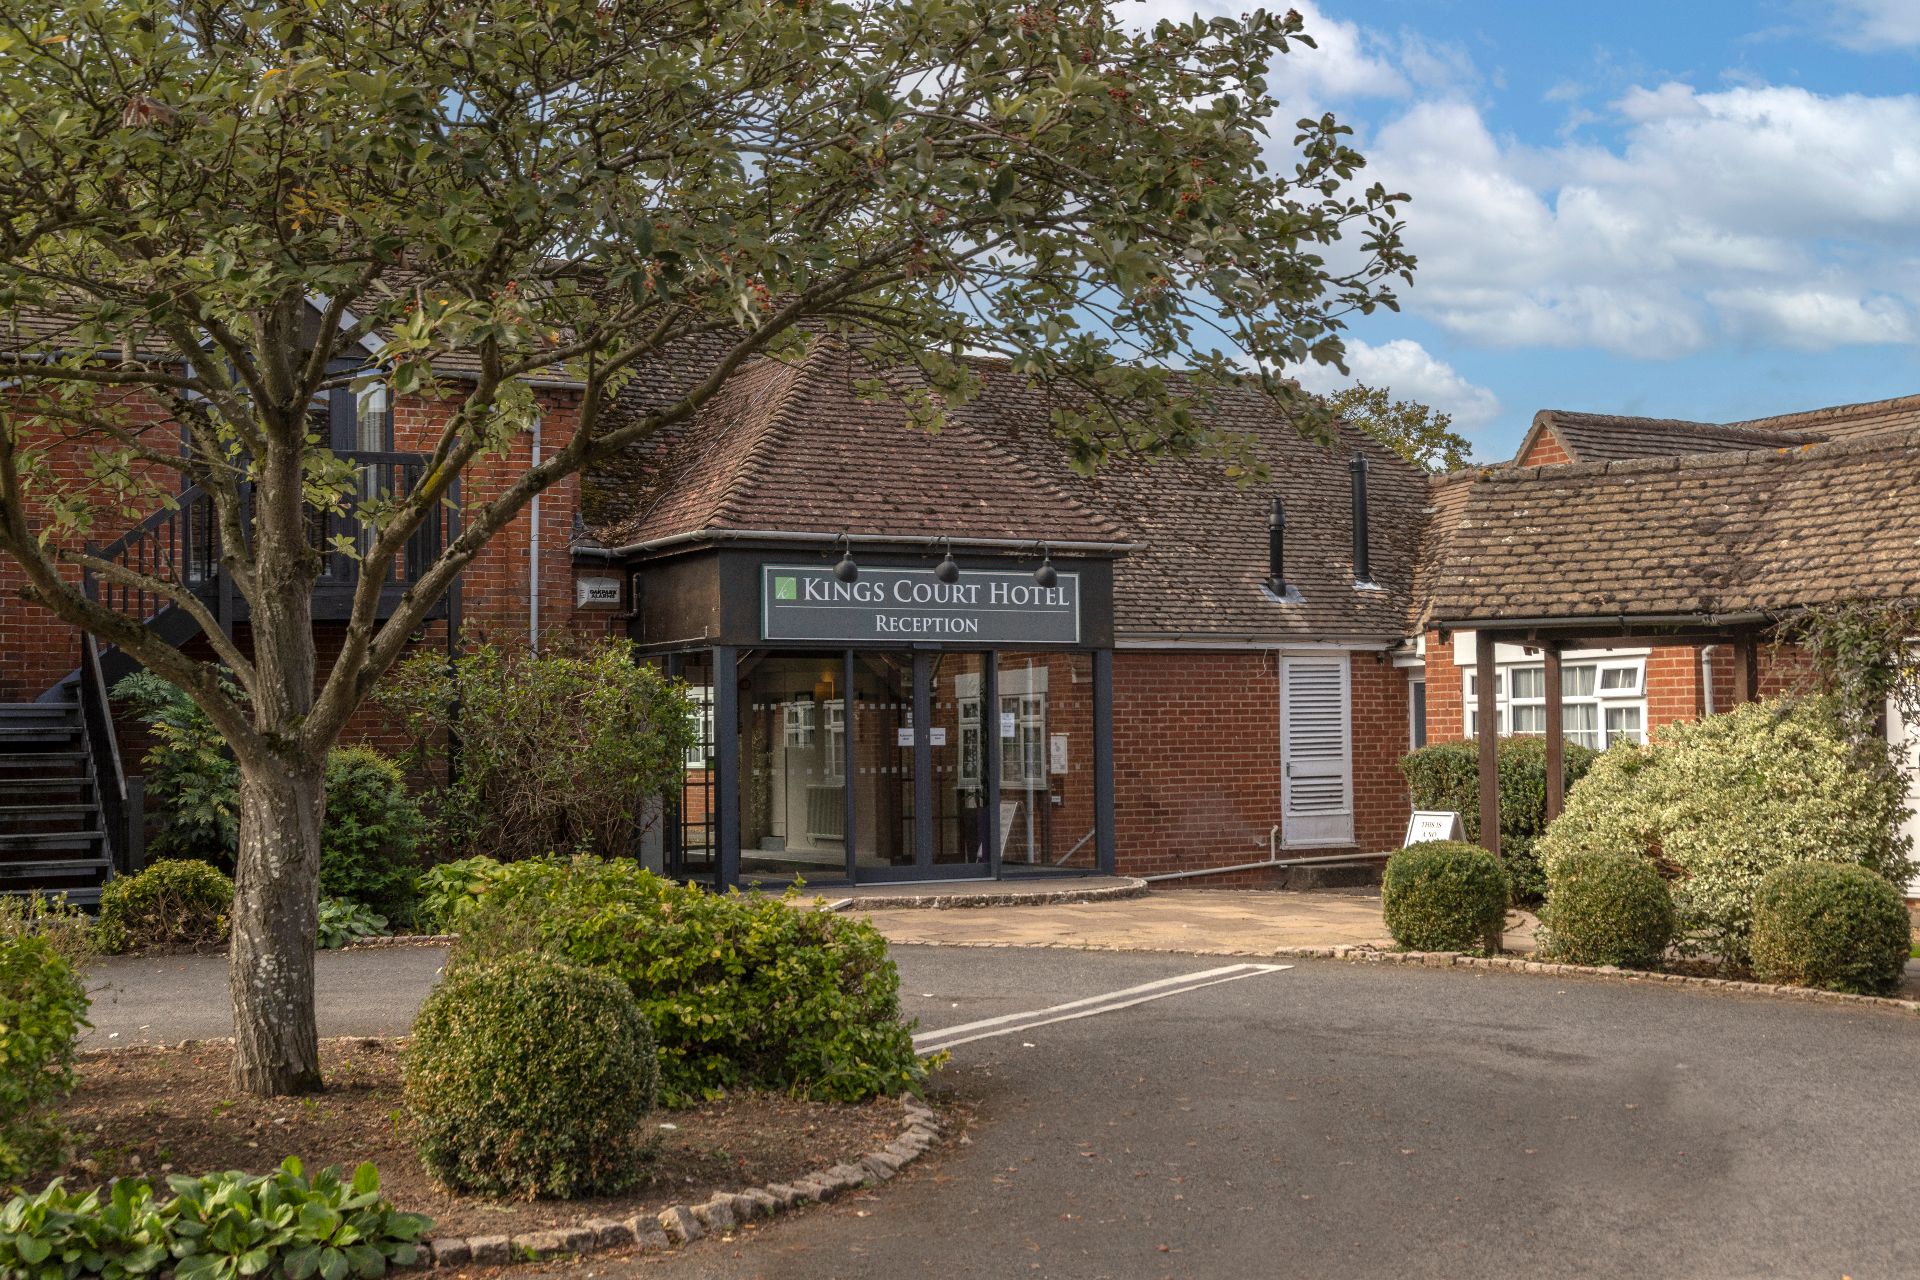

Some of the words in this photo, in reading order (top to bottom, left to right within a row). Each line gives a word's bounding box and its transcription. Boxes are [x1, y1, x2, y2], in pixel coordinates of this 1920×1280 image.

[802, 577, 885, 602] KINGS
[893, 580, 981, 604] COURT
[989, 582, 1070, 606] HOTEL
[875, 614, 979, 633] RECEPTION
